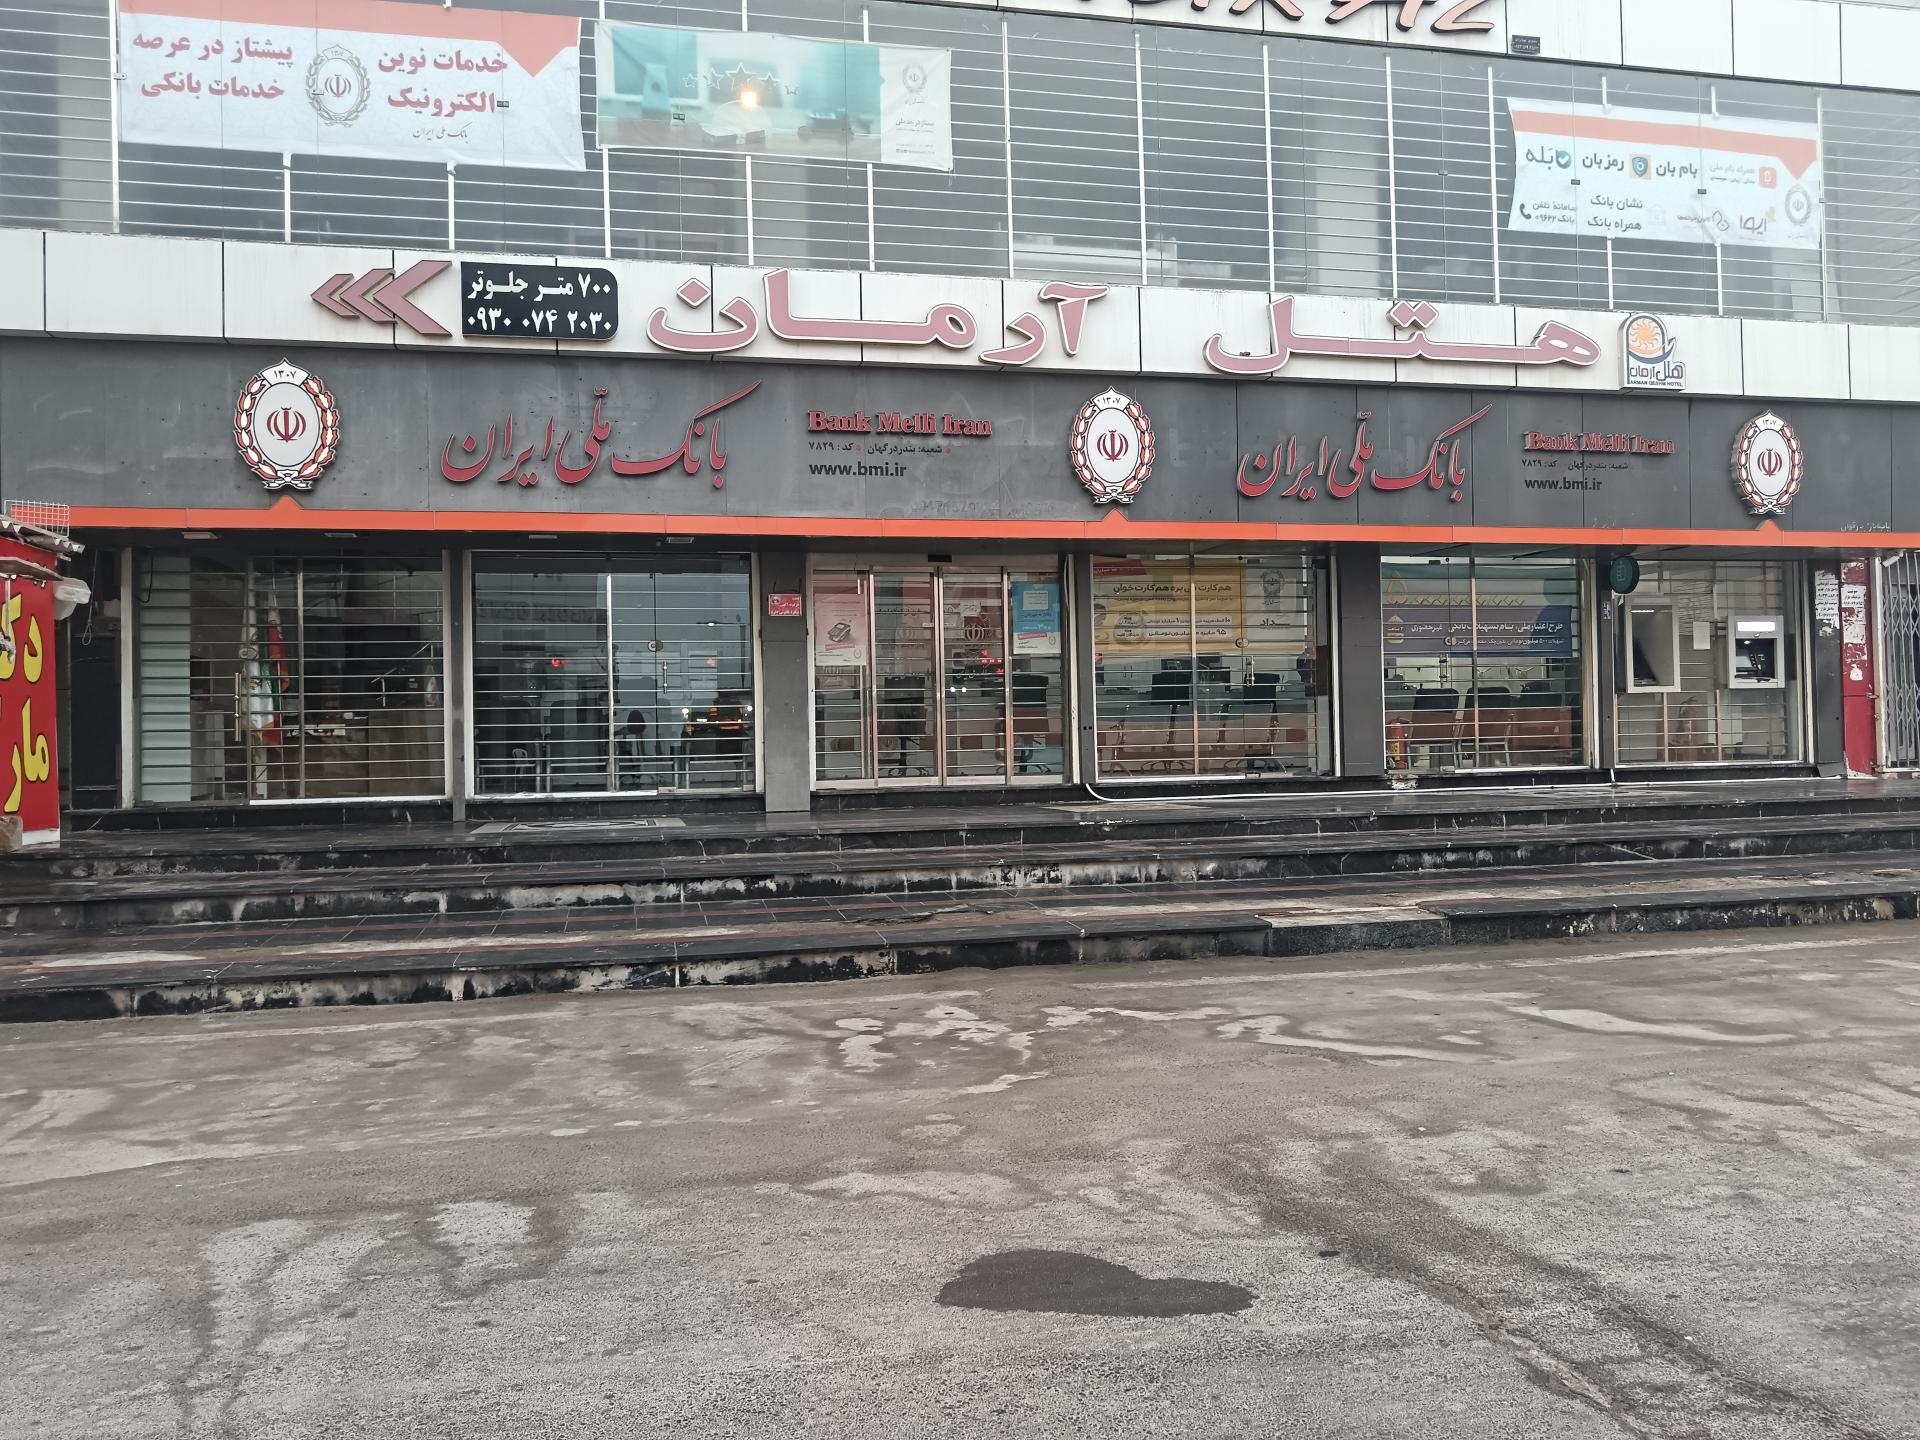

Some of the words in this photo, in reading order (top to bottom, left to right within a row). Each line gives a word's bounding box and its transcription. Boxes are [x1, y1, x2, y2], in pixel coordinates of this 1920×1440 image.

[132, 33, 191, 58] عرصه
[198, 38, 225, 61] در
[231, 36, 294, 68] پیشتاز
[378, 47, 426, 75] نوین
[433, 49, 508, 73] خدمات
[140, 71, 201, 100] بانکی
[208, 75, 285, 99] خدمات
[387, 87, 496, 118] الکترونیک
[1590, 194, 1614, 209] بانک
[1587, 216, 1612, 230] بانک
[1614, 218, 1642, 232] همراه
[467, 270, 529, 300] جلوتر
[533, 277, 574, 302] متر
[577, 272, 611, 299] ۷۰۰
[467, 306, 512, 332] ۰۹۳۰
[521, 308, 558, 333] ۰۷۴
[566, 310, 612, 335] ۲۰۳۰
[646, 267, 1110, 365] آرمان
[1203, 294, 1602, 374] هتل
[611, 380, 762, 489] بانک
[807, 410, 873, 433] Bank
[875, 411, 938, 435] Melli
[942, 413, 993, 436] Iran
[441, 414, 555, 487] ایران
[1369, 403, 1494, 502] بانک
[1523, 431, 1579, 451] Bank
[1579, 432, 1631, 453] Melli
[1631, 435, 1675, 455] Iran
[809, 461, 907, 477] www.bmi.ir
[1236, 435, 1328, 501] ایران
[1525, 477, 1602, 491] www.bmi.ir
